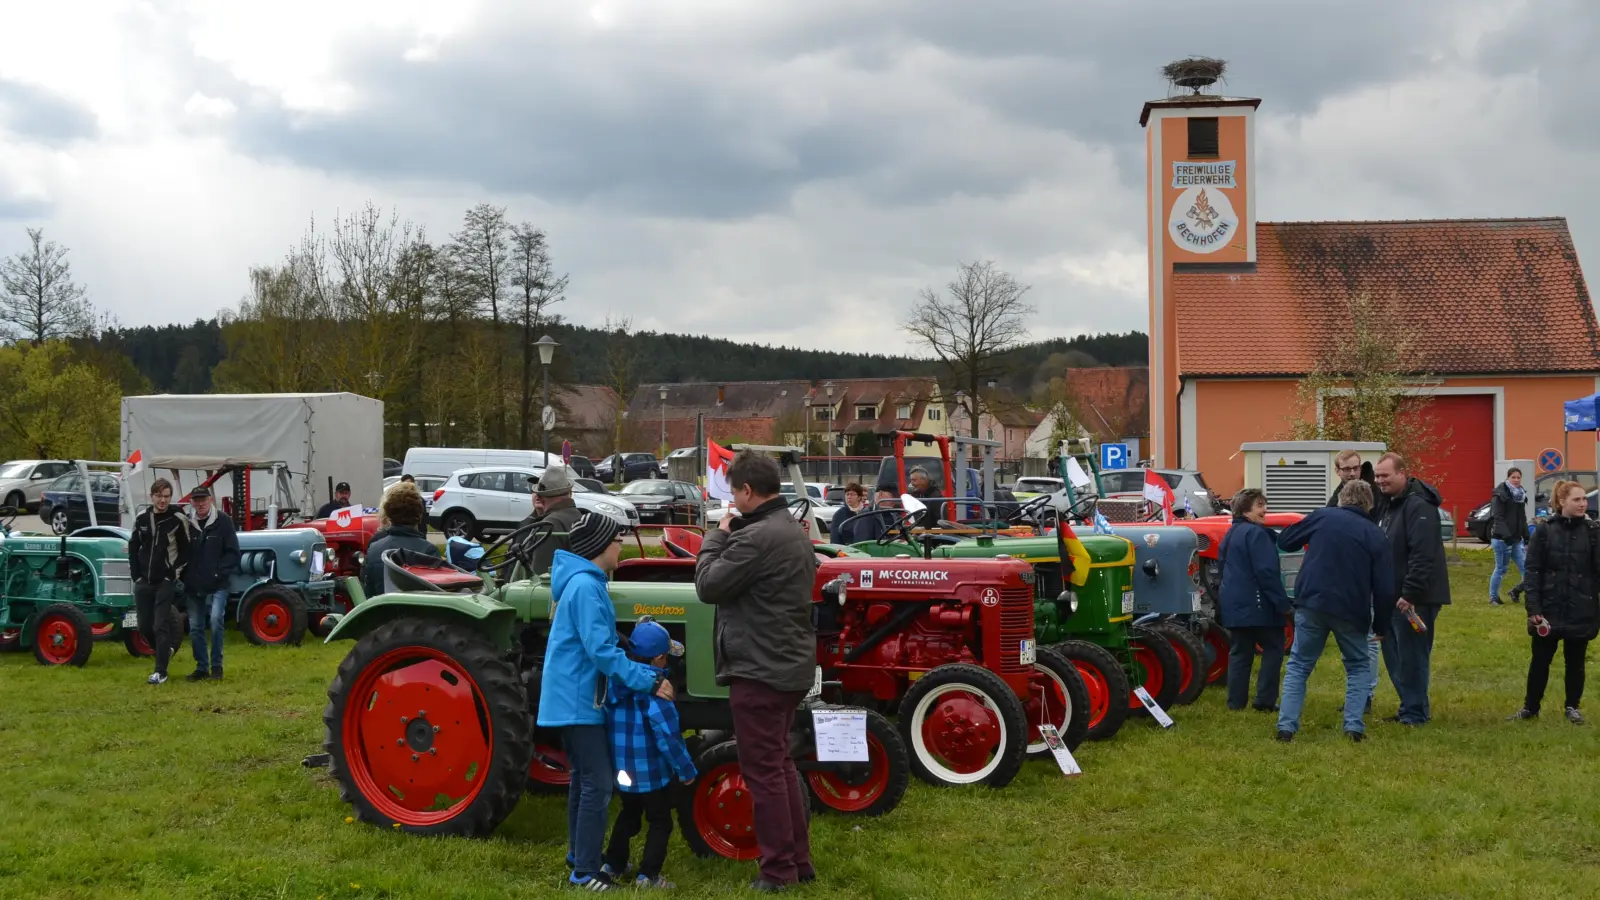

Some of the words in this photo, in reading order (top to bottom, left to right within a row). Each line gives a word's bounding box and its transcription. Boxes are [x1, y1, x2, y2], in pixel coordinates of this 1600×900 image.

[1176, 165, 1231, 175] FREIWILLIGE
[1176, 175, 1231, 185] FEUERWEHR
[1176, 221, 1229, 245] BECHHOFEN
[1107, 446, 1121, 466] P
[633, 603, 685, 615] Dieselross
